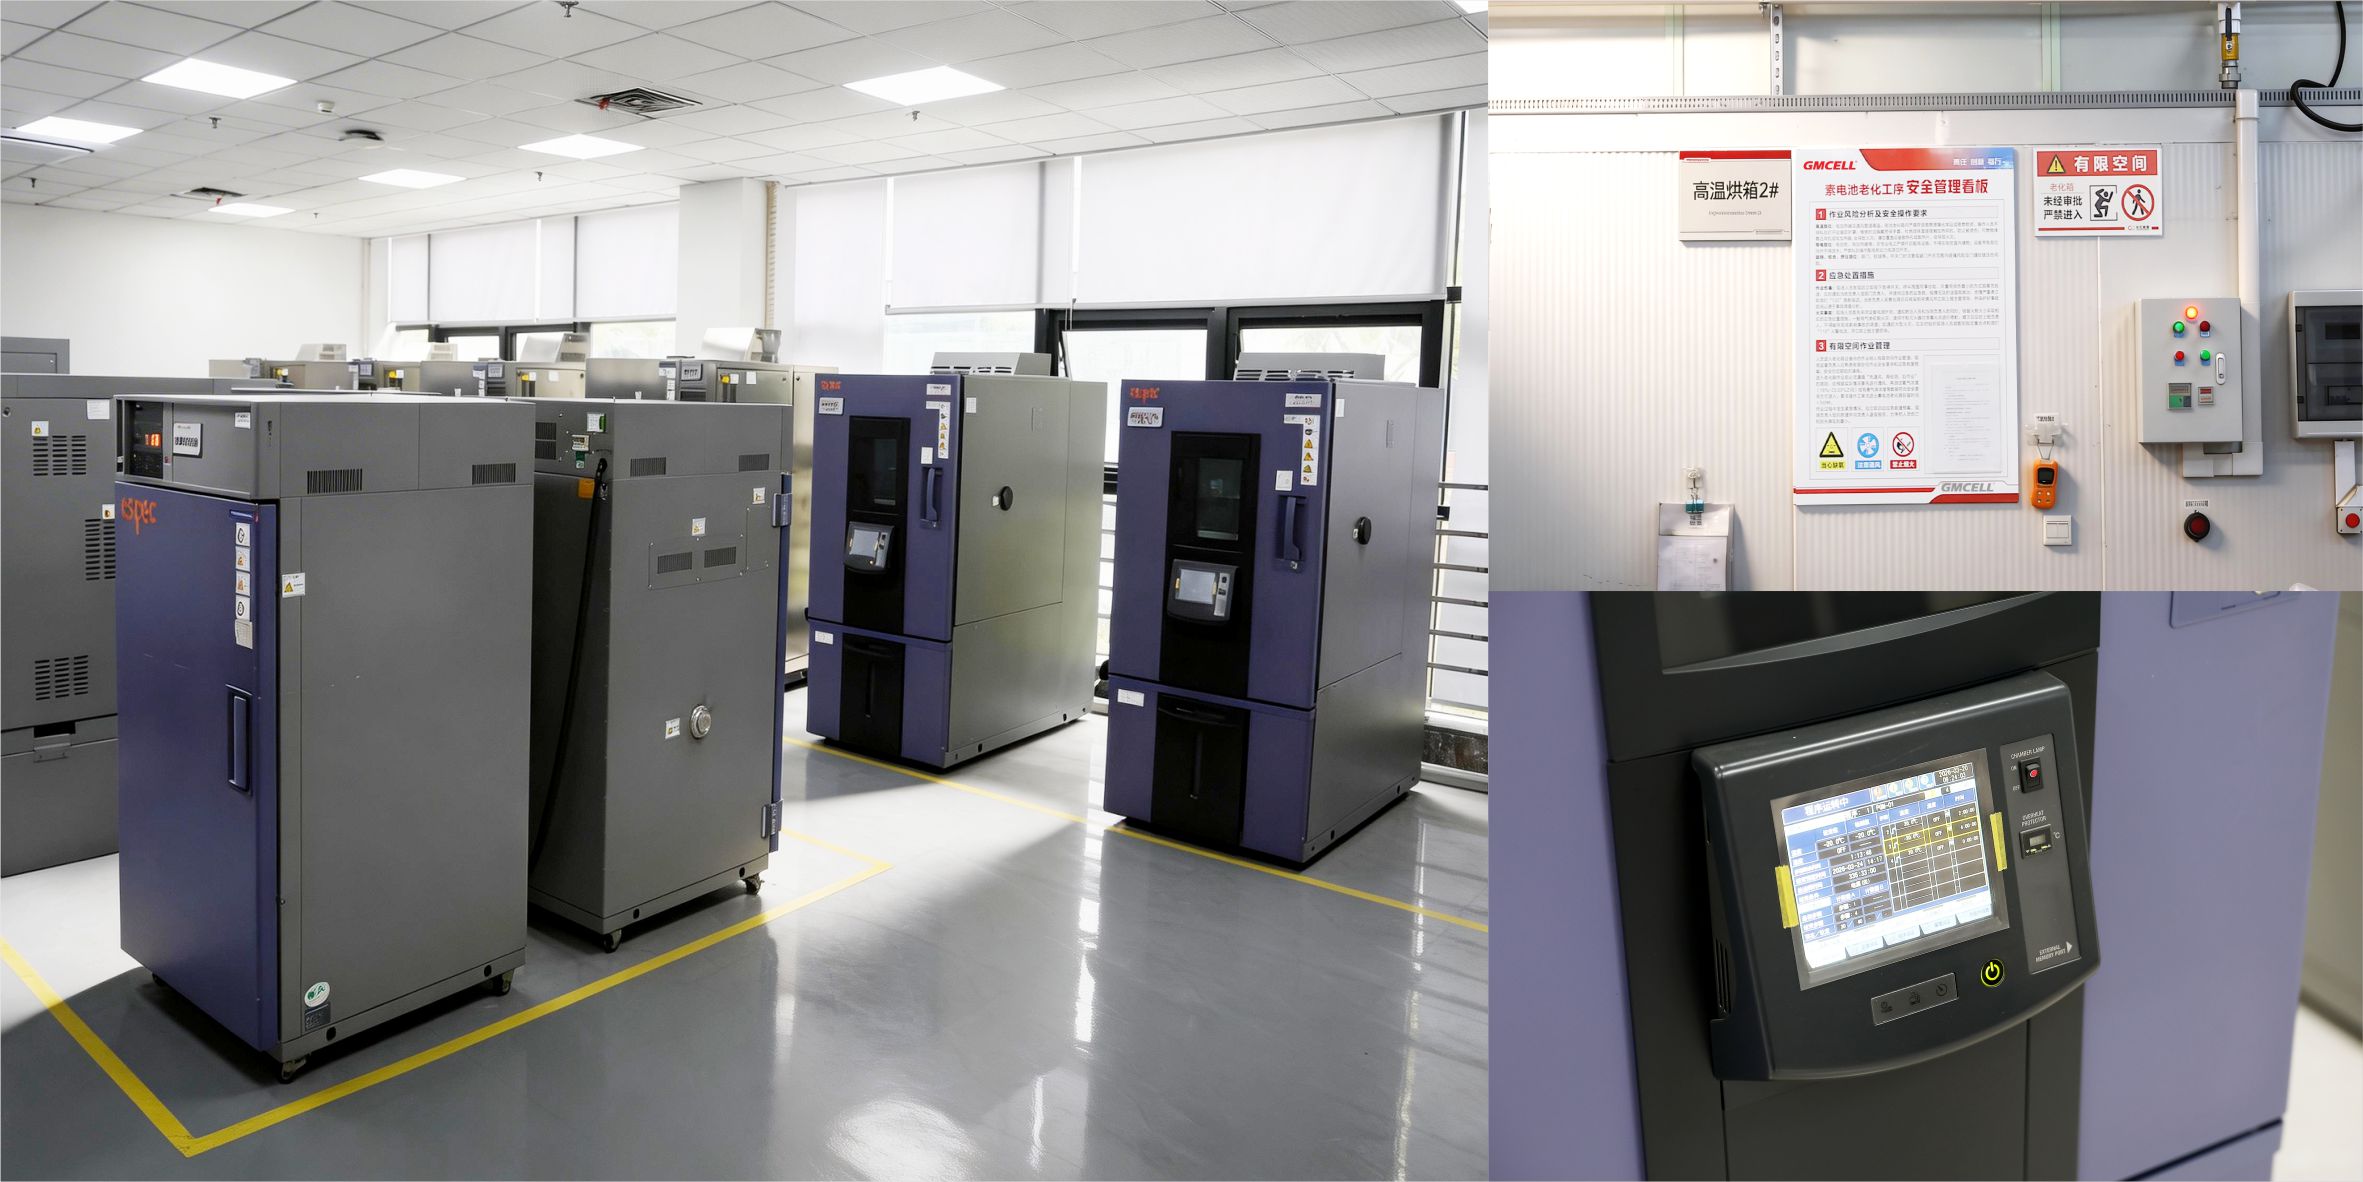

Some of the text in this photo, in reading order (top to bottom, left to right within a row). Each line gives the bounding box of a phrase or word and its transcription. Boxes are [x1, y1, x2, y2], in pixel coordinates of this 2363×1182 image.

[1803, 161, 1856, 170] GMCELL
[2074, 155, 2147, 173] 有限空间
[1692, 180, 1779, 200] 高温烘箱2#
[1825, 178, 1988, 196] 素电池老化工序 安全管理看板
[2043, 195, 2083, 206] 未经审批
[1829, 209, 1928, 219] 作业风险分析及安全操作要求
[2043, 209, 2083, 220] 严禁进入
[1829, 271, 1875, 280] 应急处置措施
[1829, 341, 1891, 350] 有限空间作业管理
[1941, 482, 1994, 492] GMCELL
[121, 497, 158, 535] espec
